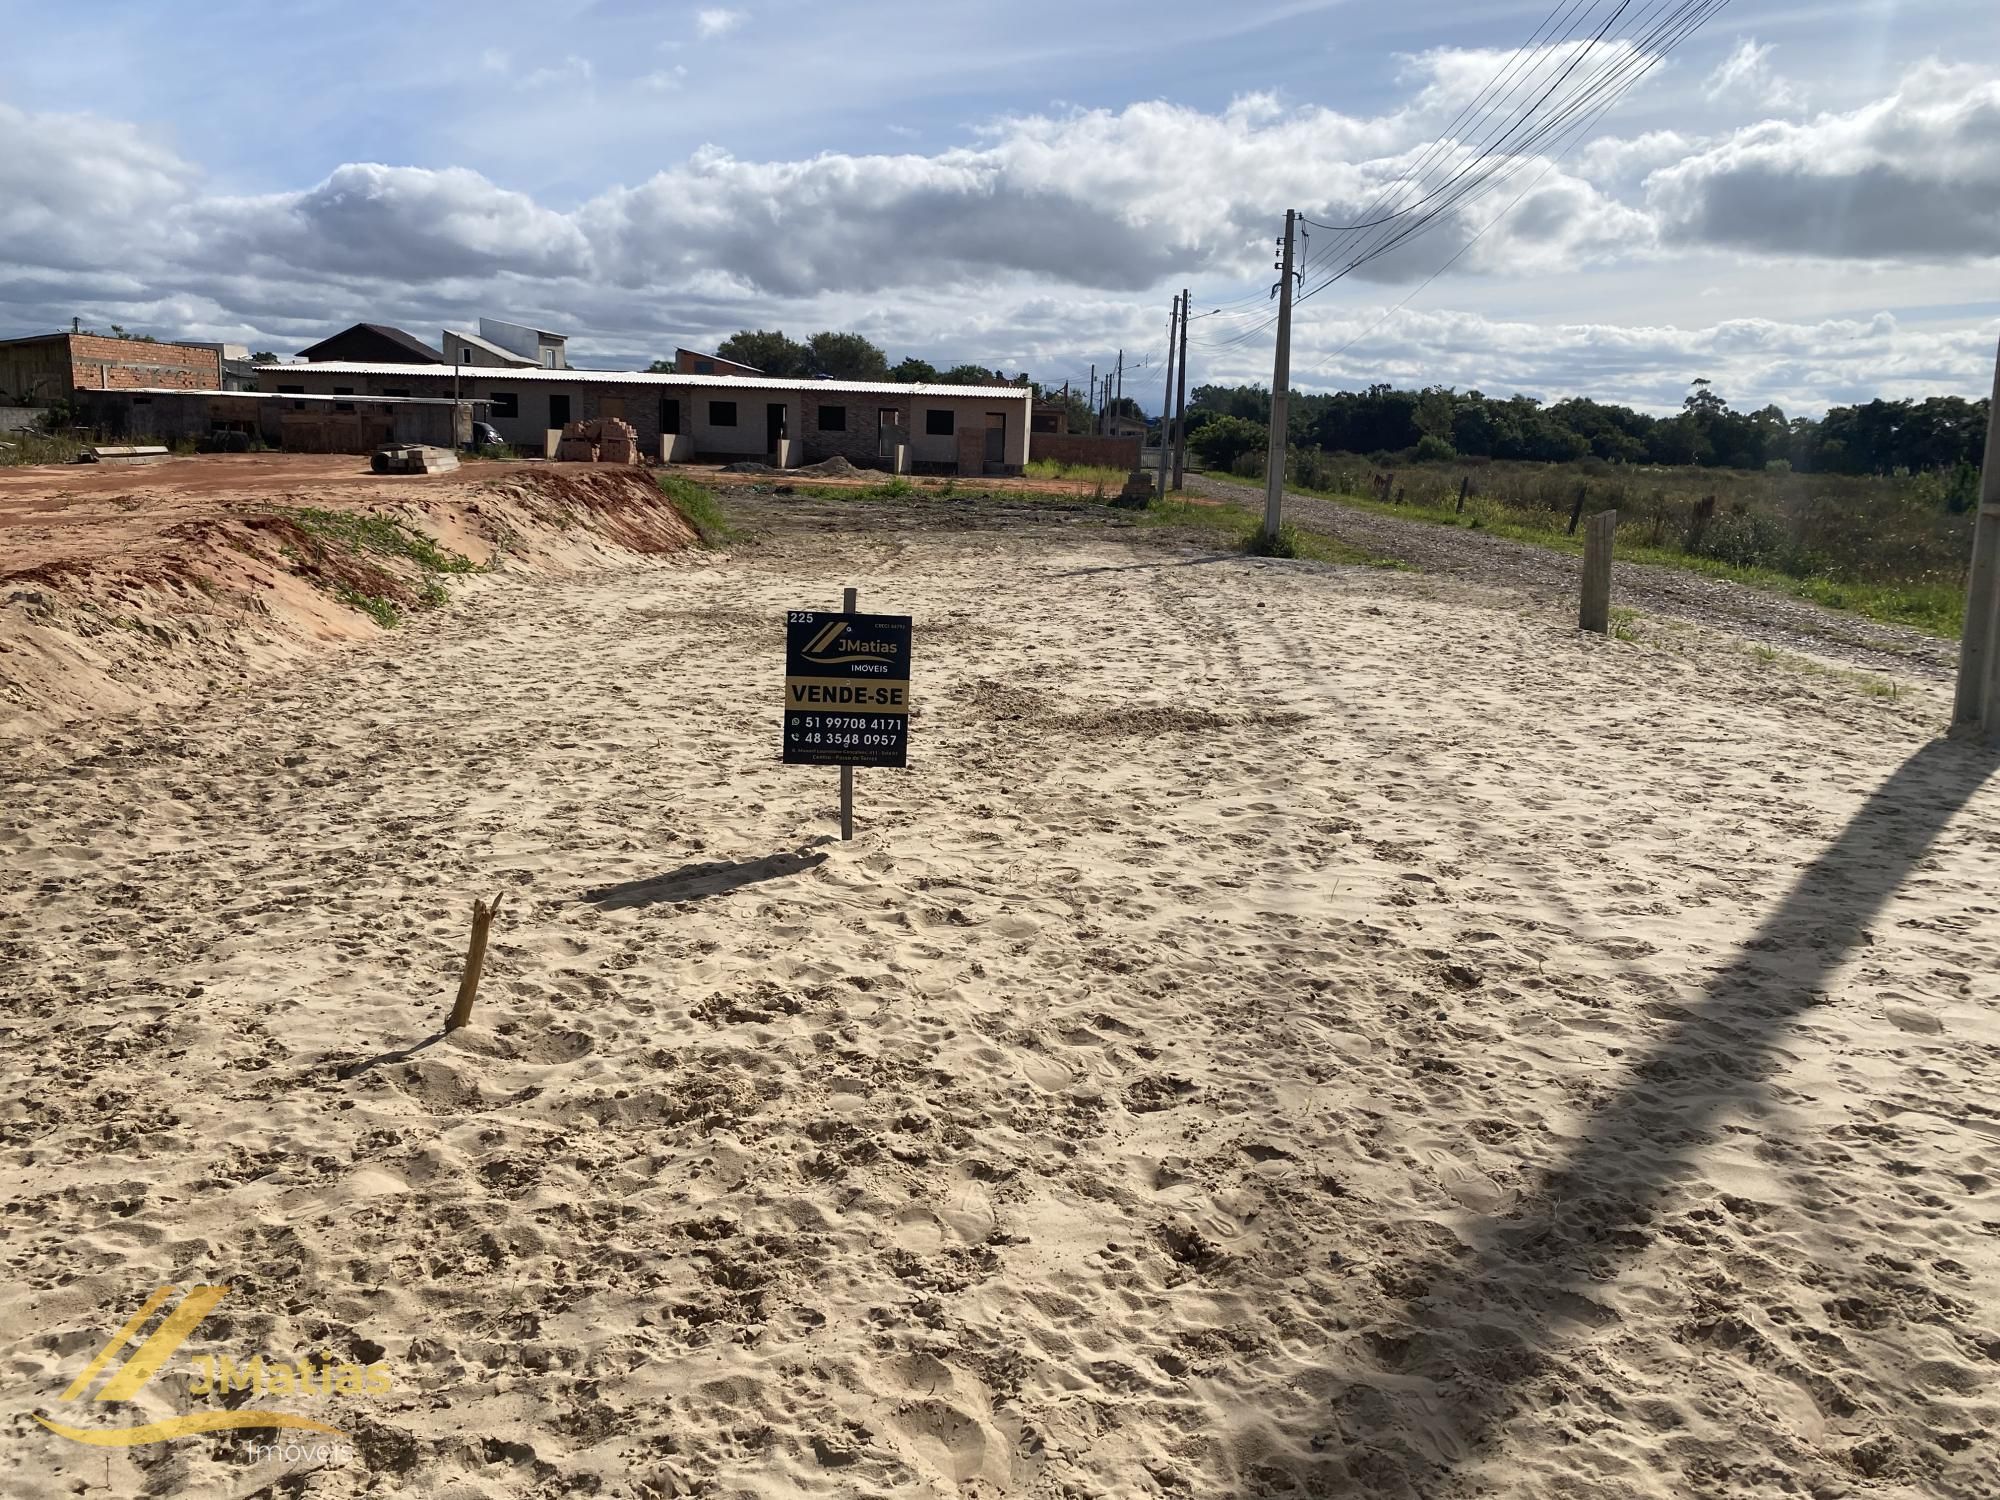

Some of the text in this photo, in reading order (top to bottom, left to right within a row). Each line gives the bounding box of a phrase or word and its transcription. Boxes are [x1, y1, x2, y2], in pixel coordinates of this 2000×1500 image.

[790, 613, 814, 623] 225
[838, 639, 898, 653] JMatias
[851, 664, 888, 673] IMÓVEIS
[791, 685, 903, 705] VENDE-SE
[805, 717, 901, 731] 51 99708 4171
[805, 732, 897, 746] 48 3548 0957
